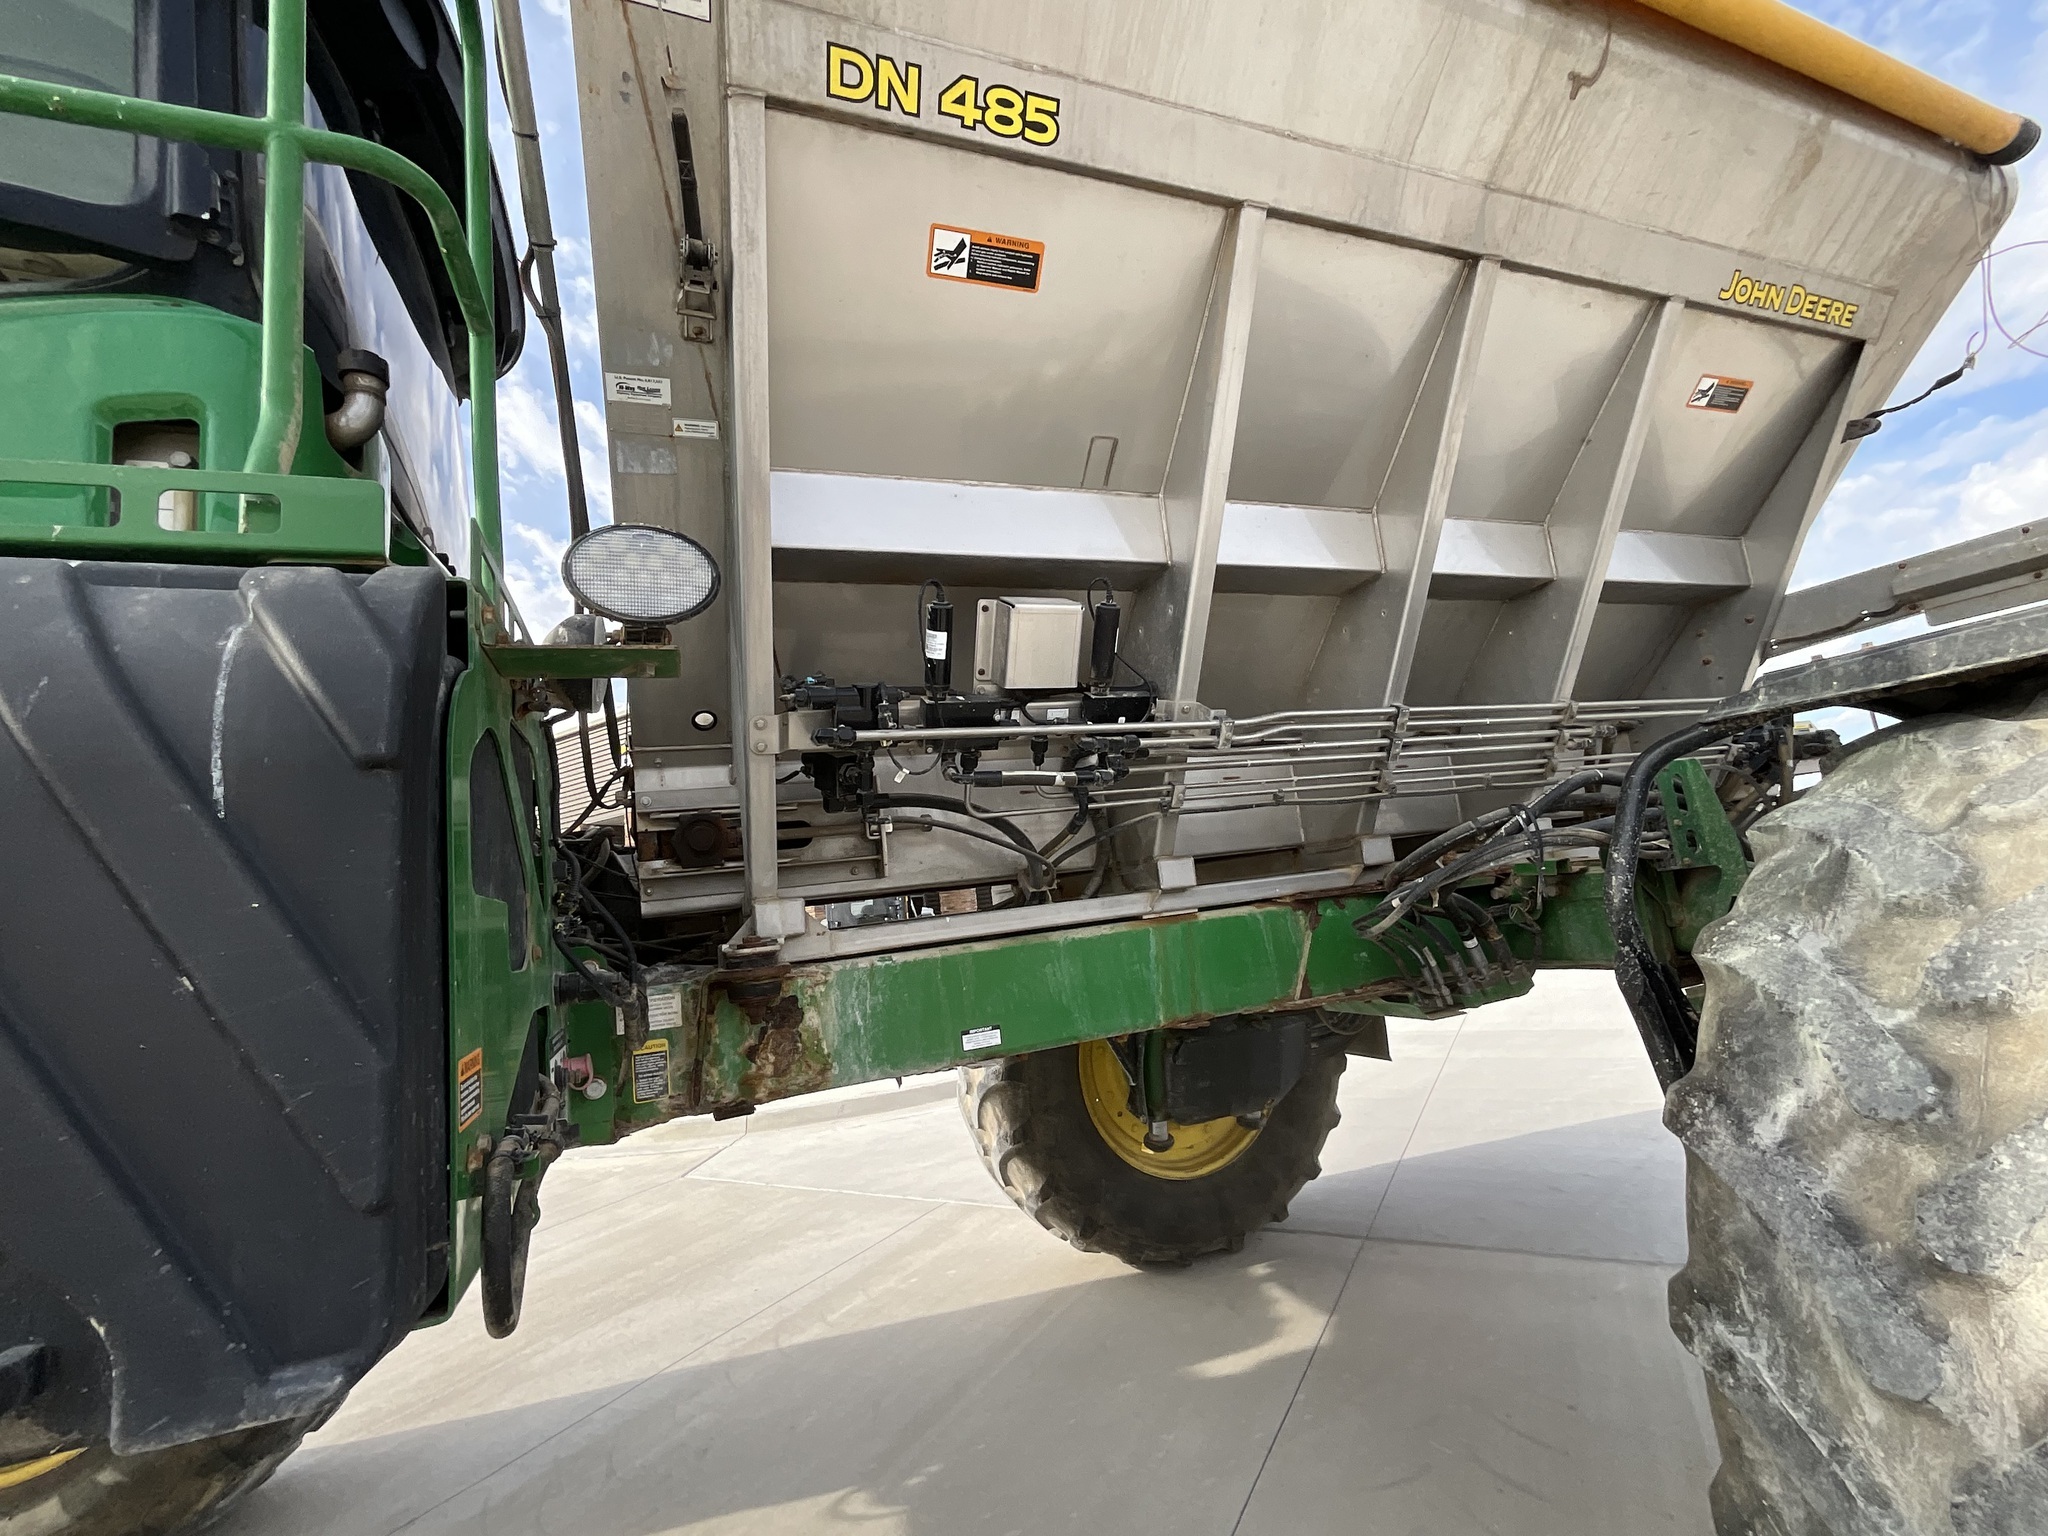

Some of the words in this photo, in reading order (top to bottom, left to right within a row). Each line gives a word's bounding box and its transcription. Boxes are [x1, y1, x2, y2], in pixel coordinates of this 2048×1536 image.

[827, 41, 921, 118] DN
[938, 74, 1060, 146] 485
[996, 237, 1030, 250] WARNING
[1718, 269, 1786, 312] JOHN
[1783, 284, 1859, 328] DEERE
